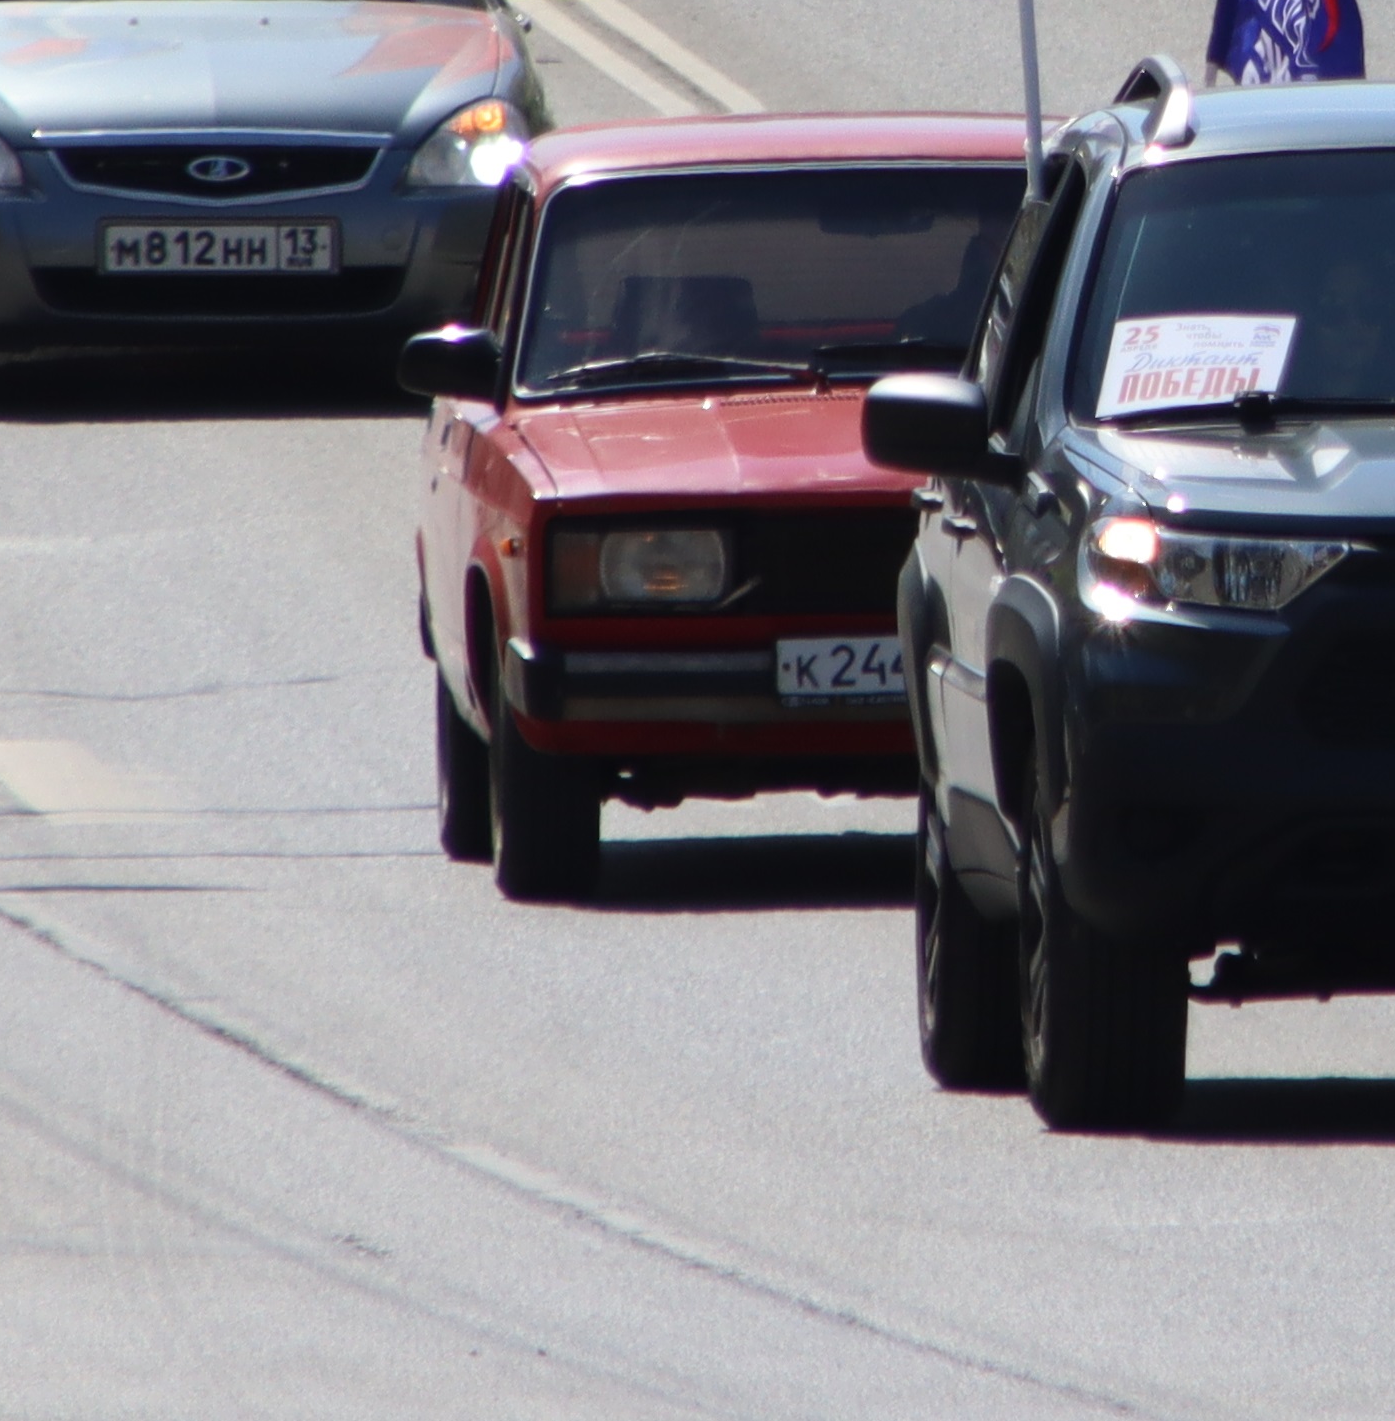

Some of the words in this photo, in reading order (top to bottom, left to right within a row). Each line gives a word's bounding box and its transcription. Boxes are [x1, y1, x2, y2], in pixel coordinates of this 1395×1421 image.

[114, 230, 268, 266] М812НН
[285, 228, 317, 256] 13
[1124, 324, 1161, 346] 25
[1124, 350, 1264, 374] Диктант
[1116, 366, 1262, 405] ПОБЕДЫ
